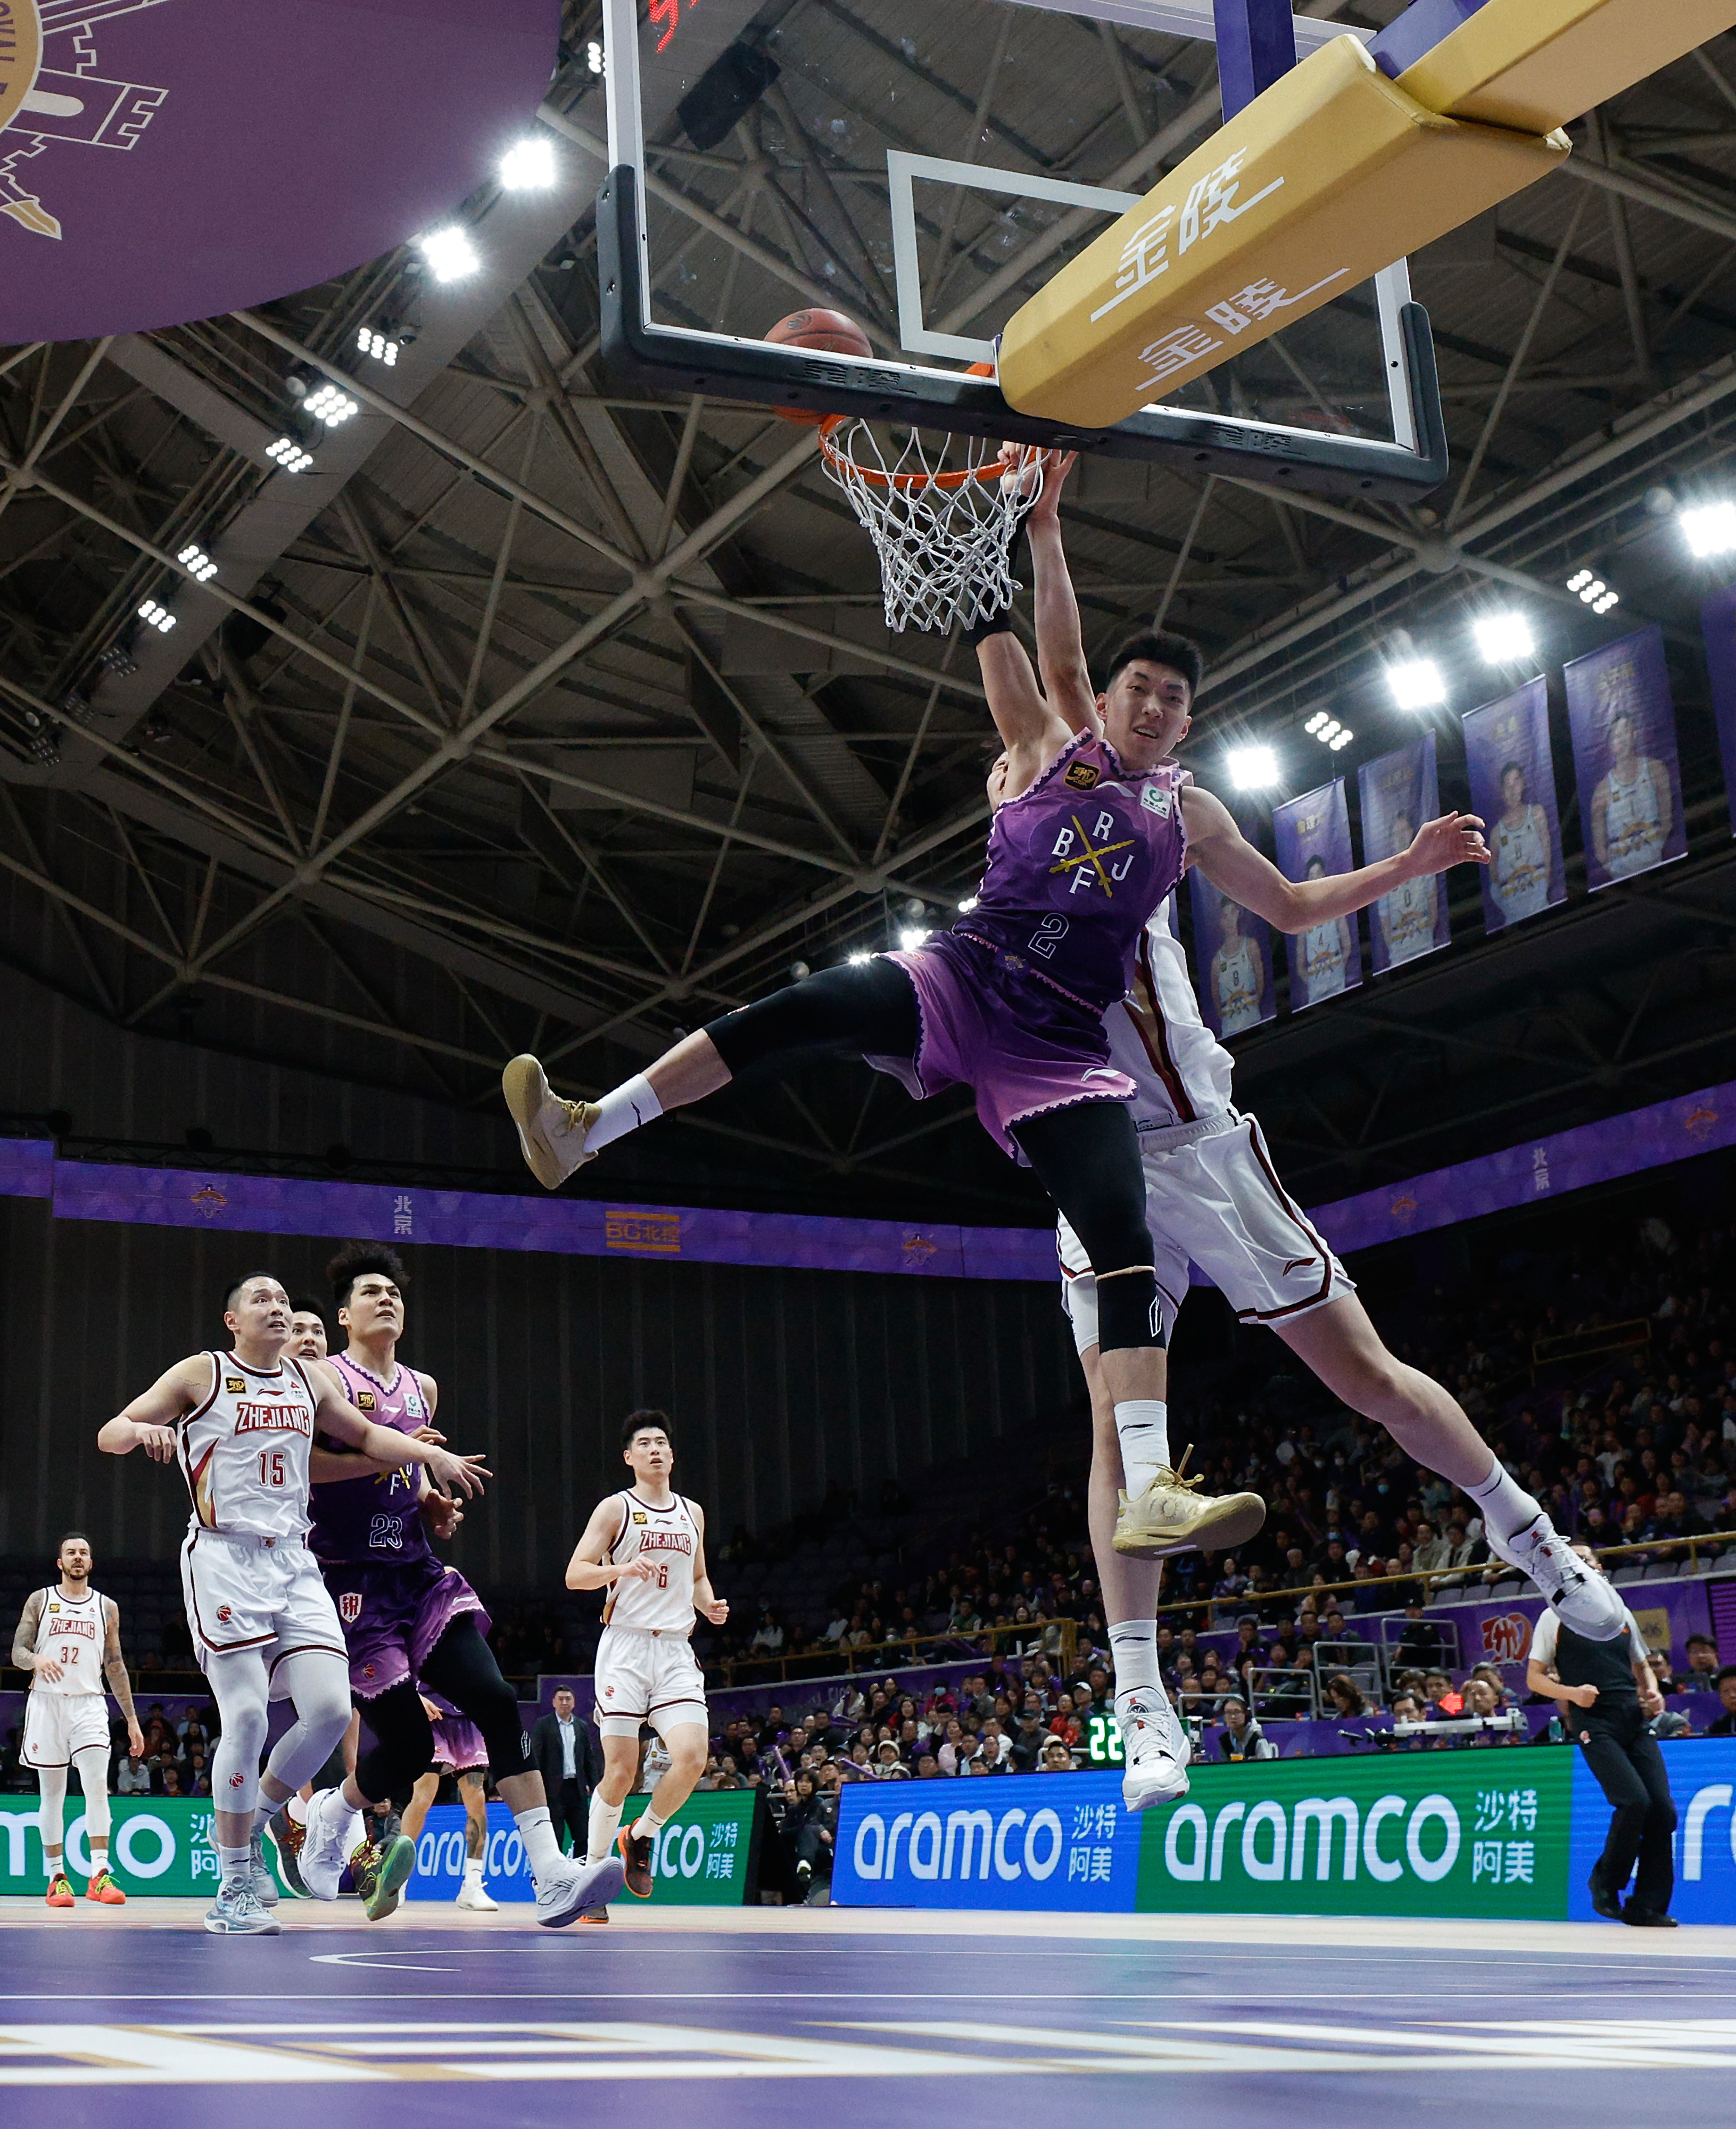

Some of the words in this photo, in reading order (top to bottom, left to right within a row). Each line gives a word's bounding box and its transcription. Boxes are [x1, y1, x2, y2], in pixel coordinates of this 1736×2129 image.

[1052, 827, 1075, 857] B
[1092, 811, 1114, 841] R
[1069, 866, 1095, 894] F
[1111, 854, 1135, 881] J
[1028, 912, 1069, 959] 2
[394, 1195, 412, 1234] 北京
[236, 1403, 310, 1438] ZHEJIANG
[258, 1451, 286, 1487] 15
[369, 1514, 403, 1549] 23
[640, 1531, 691, 1556] ZHEJIANG
[49, 1618, 95, 1640] ZHEJIANG
[61, 1646, 79, 1664] 32
[1090, 1717, 1123, 1760] 22
[1071, 1804, 1117, 1840] 沙特
[1474, 1789, 1538, 1833] 沙特
[709, 1822, 739, 1848] 沙特
[854, 1808, 1063, 1880] aramco
[1164, 1794, 1461, 1883] aramco
[417, 1830, 523, 1877] araco
[706, 1853, 735, 1879] 阿美
[1068, 1846, 1113, 1883] 阿美
[1472, 1841, 1534, 1883] 阿美
